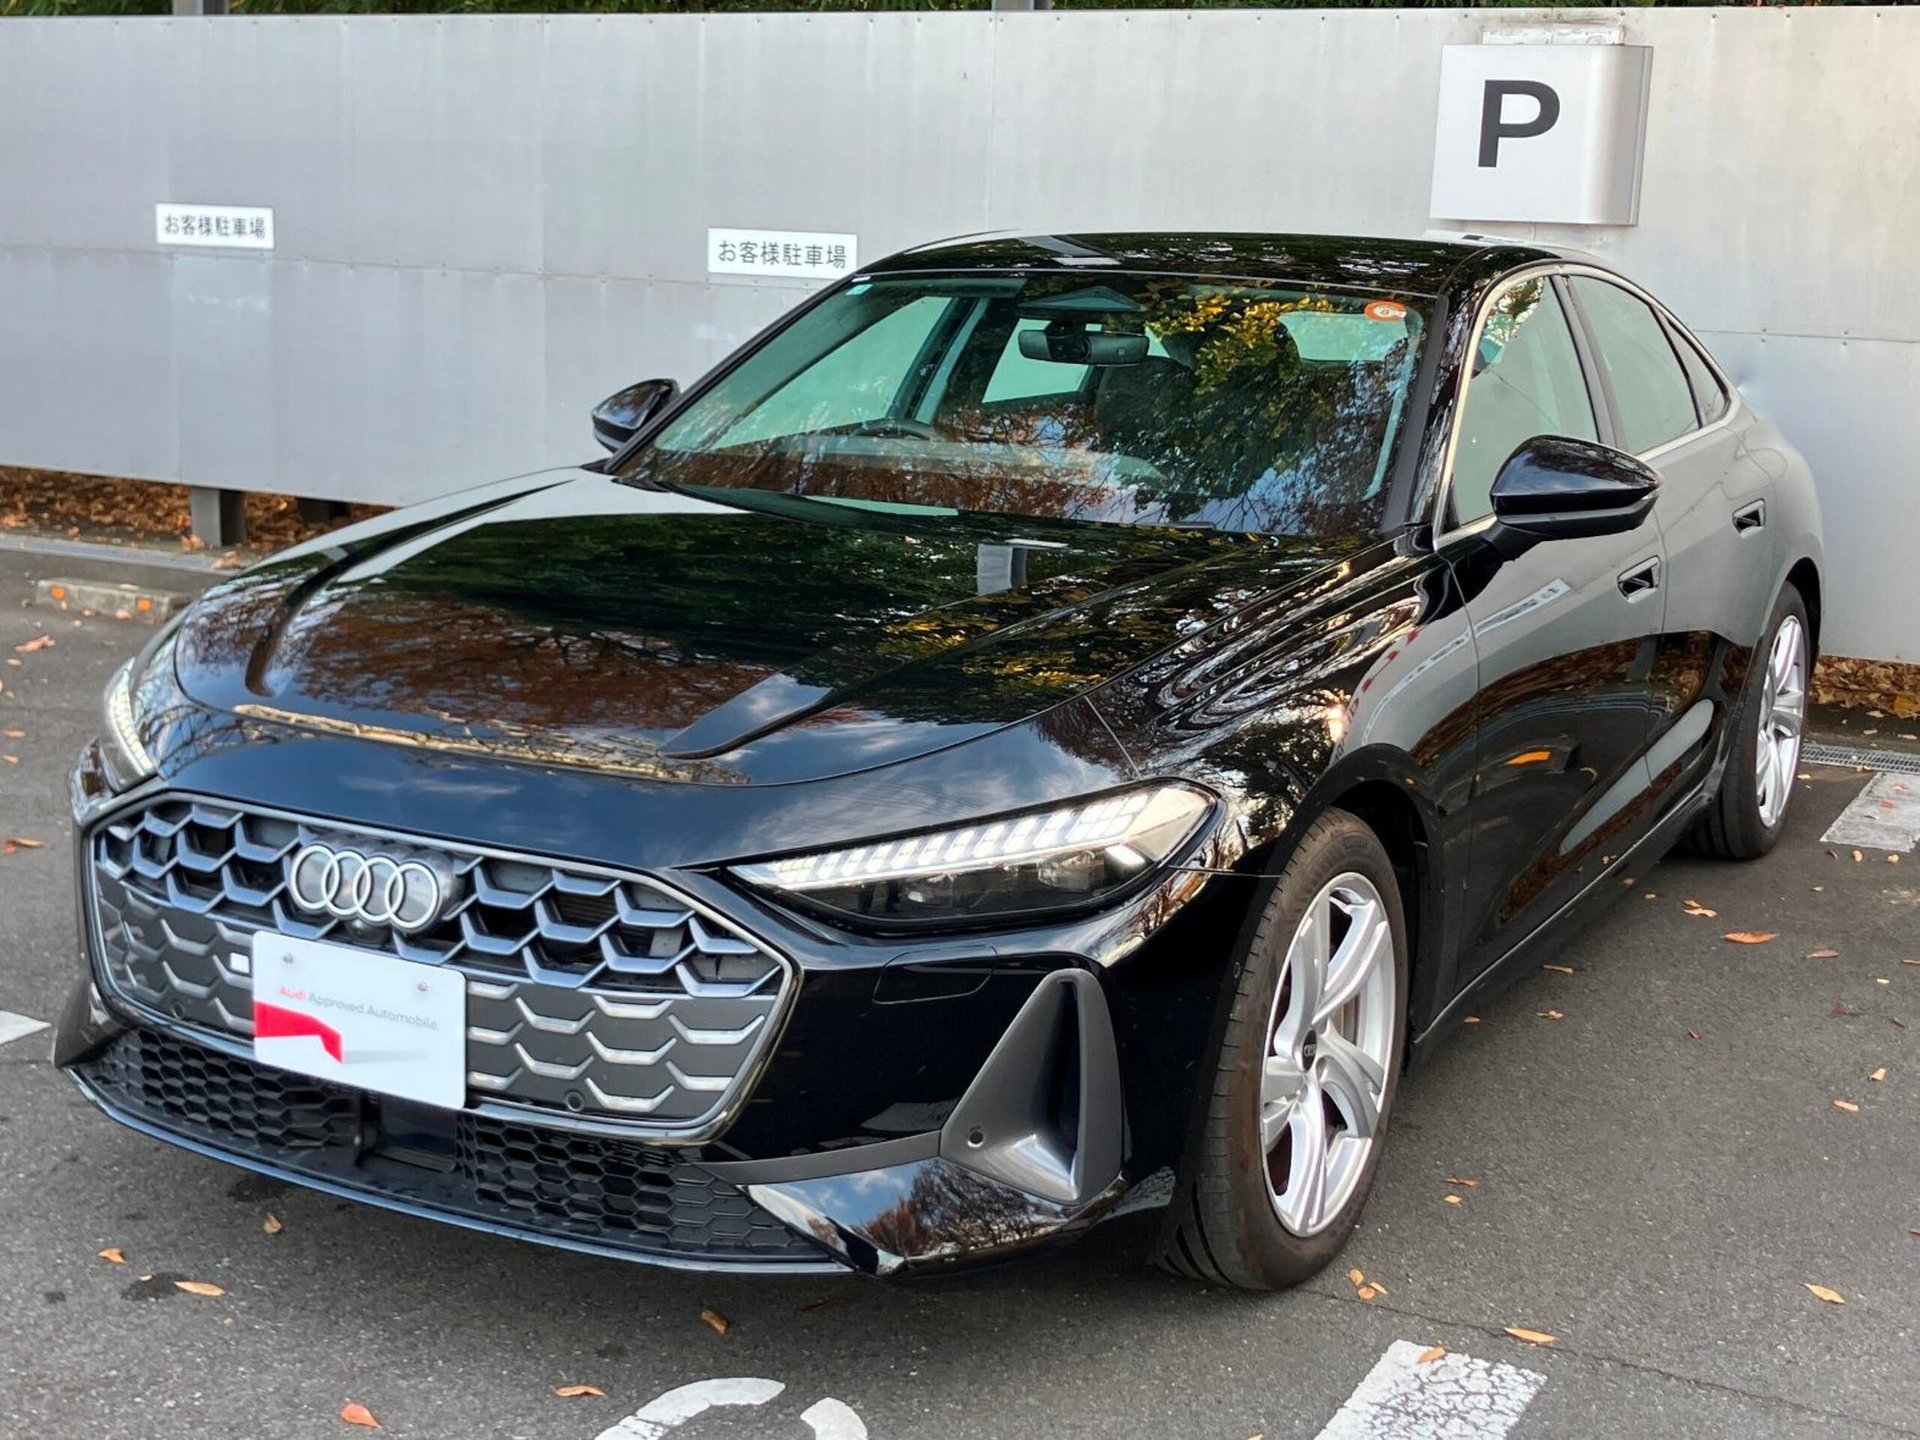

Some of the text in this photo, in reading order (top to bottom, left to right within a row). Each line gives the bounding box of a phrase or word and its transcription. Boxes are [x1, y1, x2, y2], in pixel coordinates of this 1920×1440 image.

[1478, 79, 1560, 168] P
[165, 214, 266, 240] お客様駐車場
[718, 240, 847, 269] お客様駐車場
[278, 985, 438, 1030] Audi Approved Automobile
